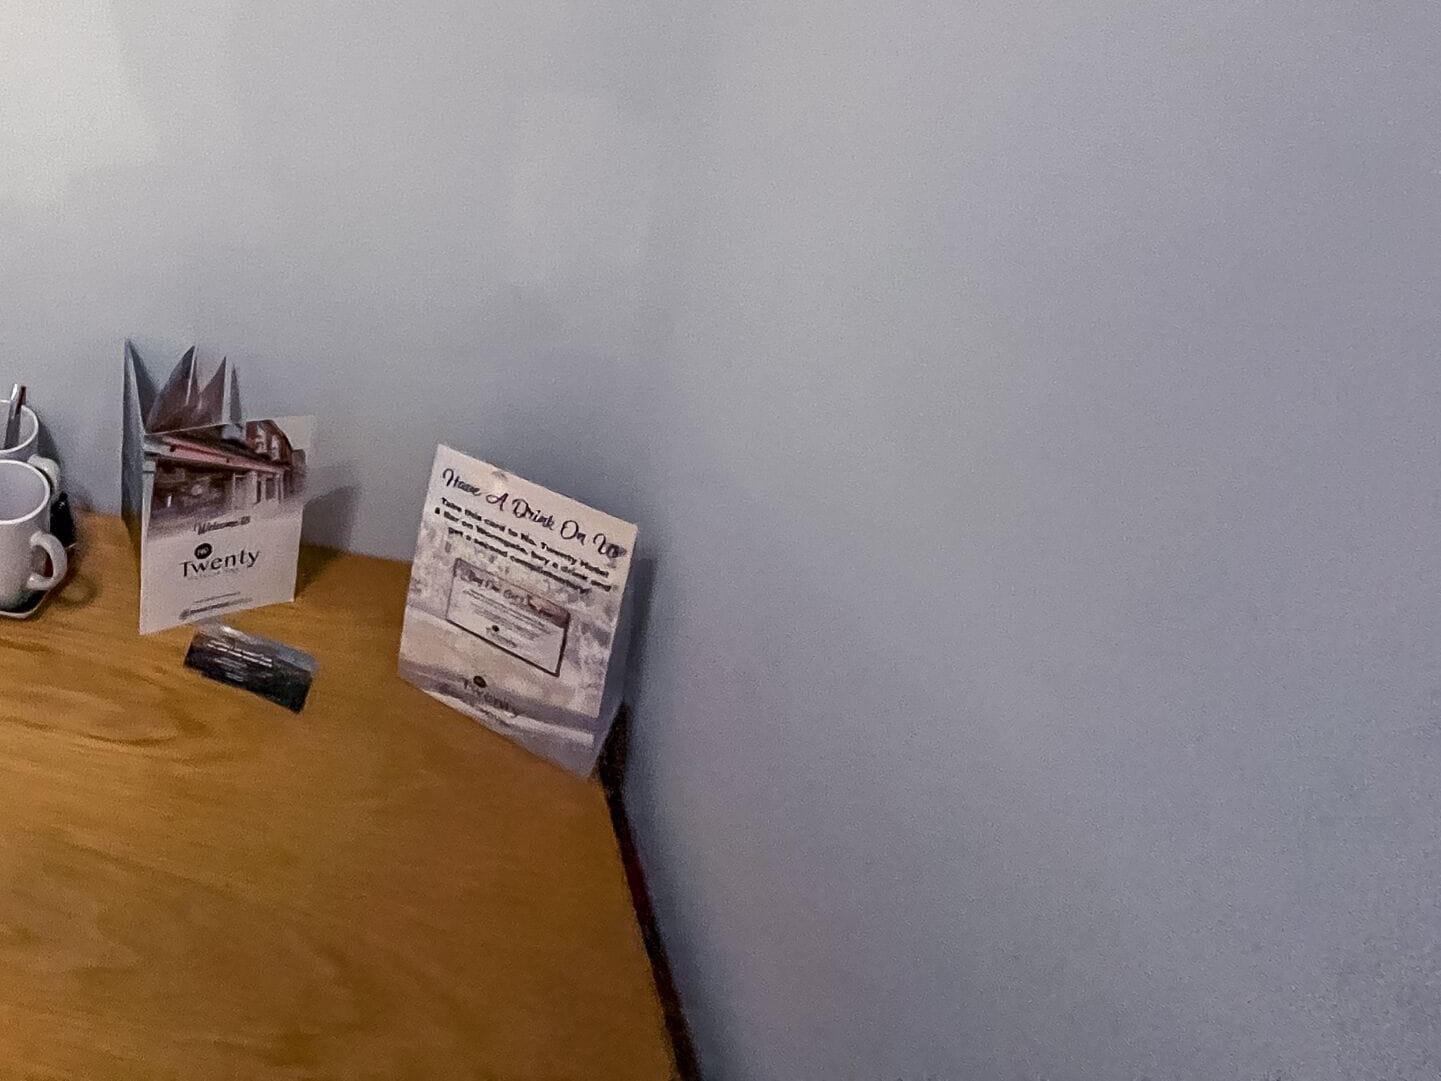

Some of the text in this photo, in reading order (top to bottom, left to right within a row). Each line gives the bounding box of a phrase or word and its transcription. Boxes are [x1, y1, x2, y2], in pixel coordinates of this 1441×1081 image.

[442, 468, 481, 496] Have
[486, 492, 508, 512] A
[512, 498, 555, 531] Drink
[560, 520, 586, 546] On
[179, 549, 260, 577] Twenty
[462, 521, 473, 530] on
[531, 550, 550, 566] buy
[561, 566, 588, 581] drink
[590, 580, 612, 593] and
[474, 539, 508, 558] second
[484, 519, 505, 532] card
[508, 528, 518, 537] to
[541, 541, 577, 566] Twenty
